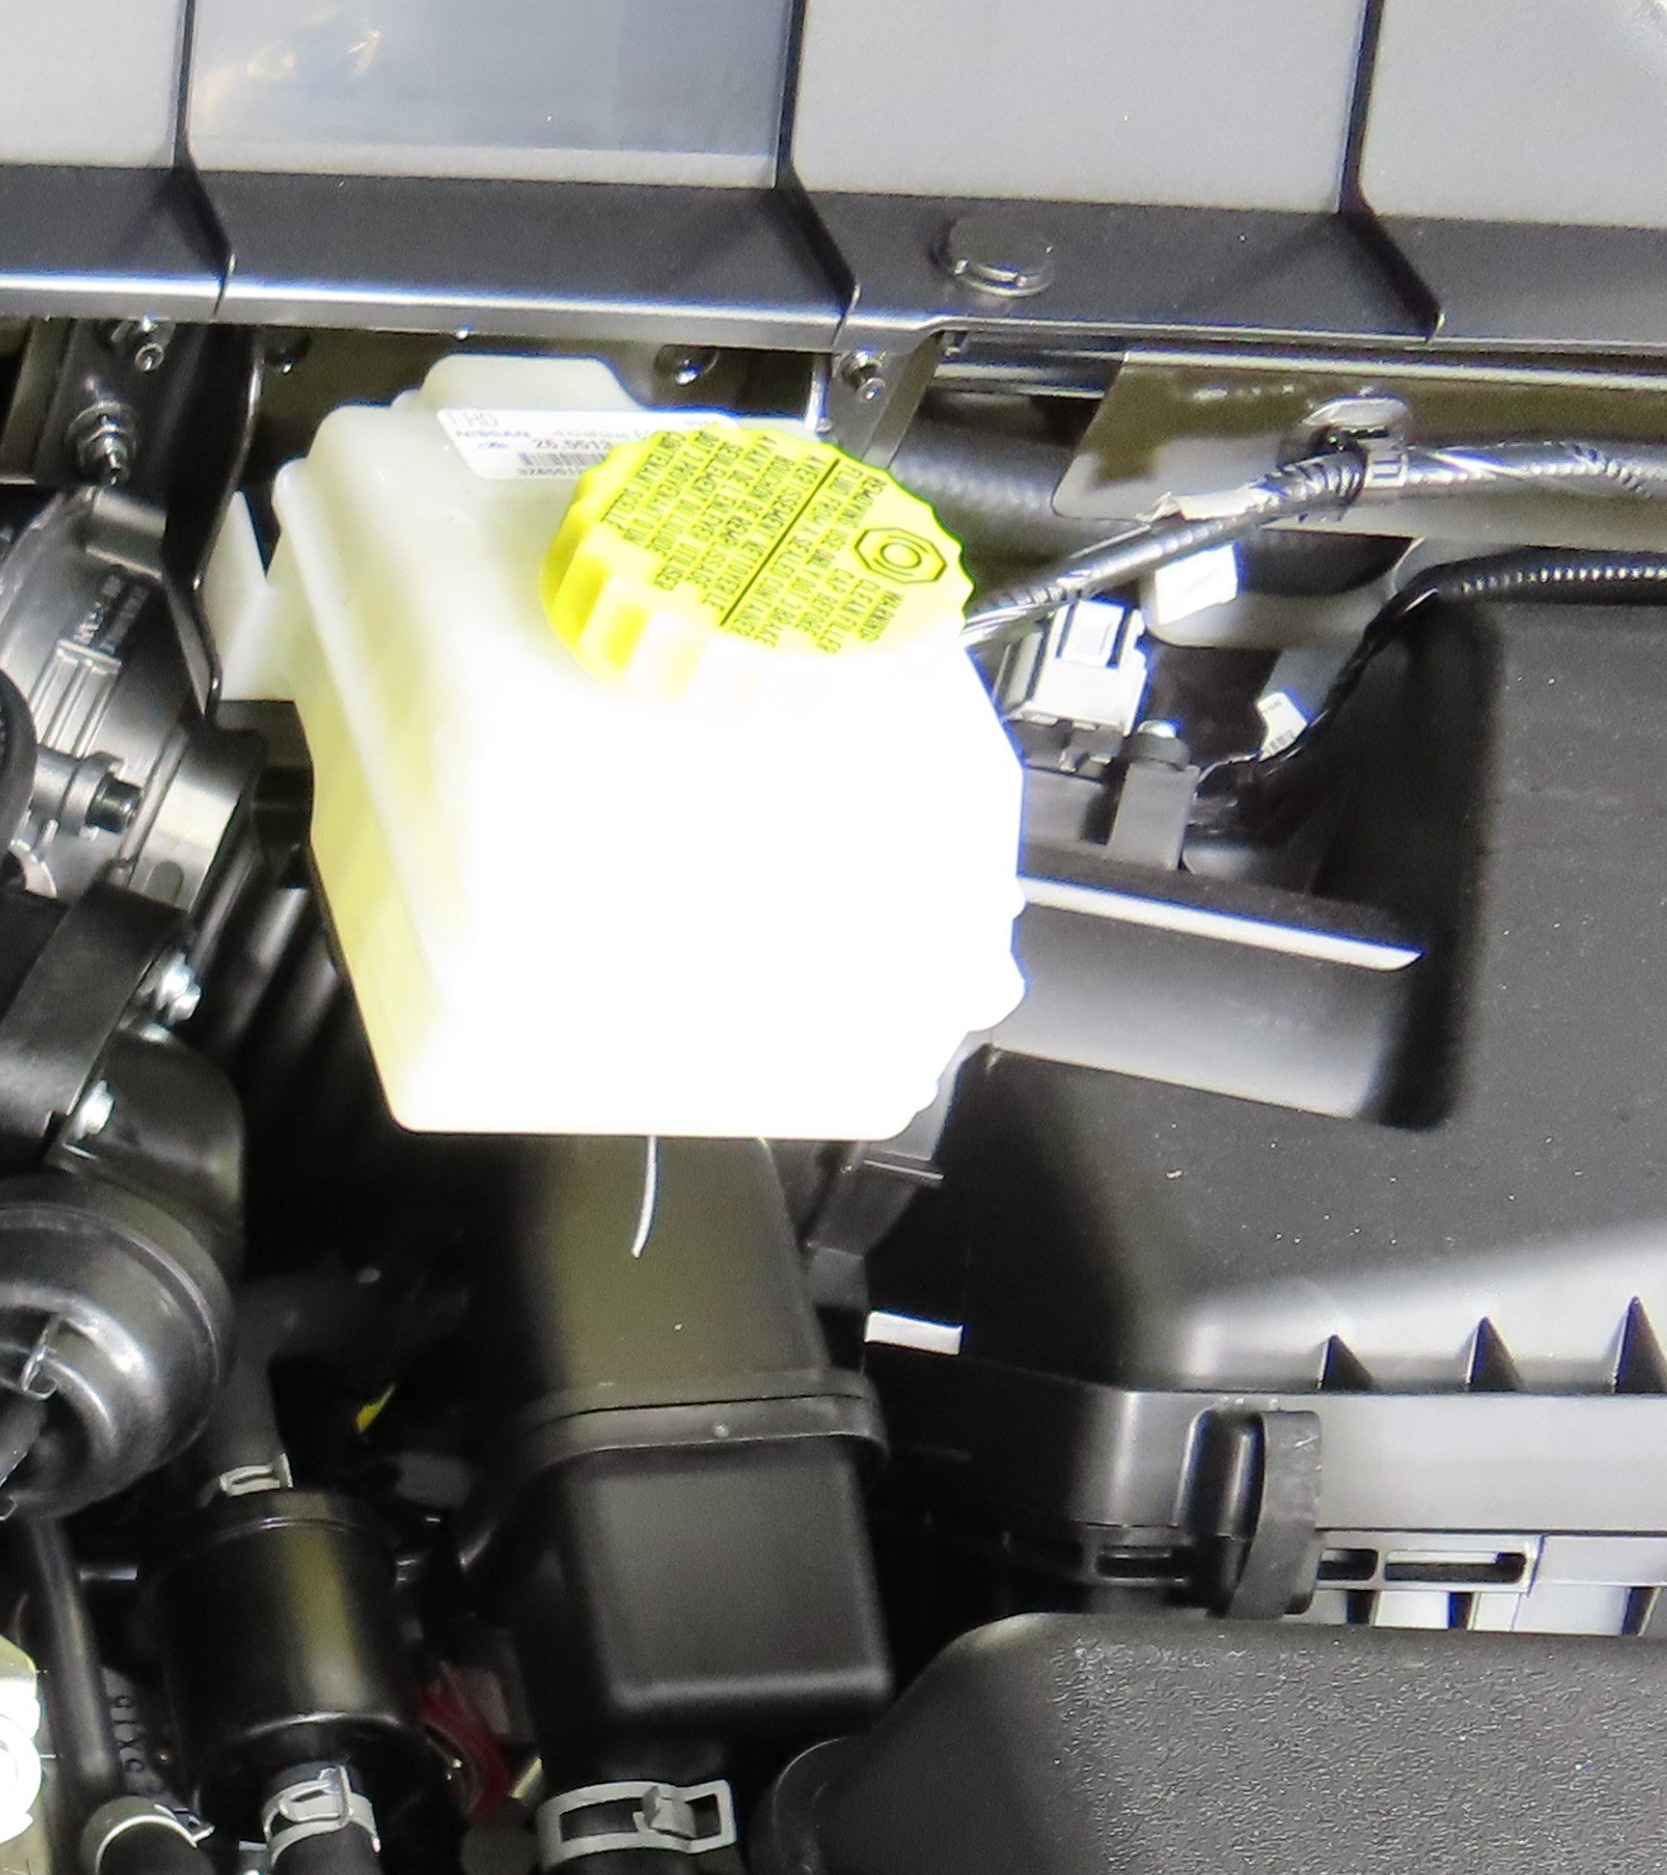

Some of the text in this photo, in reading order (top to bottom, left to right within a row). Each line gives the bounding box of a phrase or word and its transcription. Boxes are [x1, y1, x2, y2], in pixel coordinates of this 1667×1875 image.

[688, 429, 720, 455] DOT
[738, 433, 779, 472] AVANT
[726, 468, 754, 488] DE
[826, 463, 864, 497] FLUID
[736, 498, 764, 518] DE
[805, 493, 842, 527] FROM
[798, 524, 820, 537] A
[819, 527, 850, 552] USE
[683, 513, 753, 591] REMPLISSAGE
[767, 533, 814, 580] SEALED
[800, 547, 837, 579] ONLY
[779, 597, 802, 610] 3
[785, 575, 817, 601] DOT
[793, 566, 857, 637] CAP BEFORE
[752, 606, 796, 648] BRAKE
[813, 577, 881, 656] CLEAN FILLER
